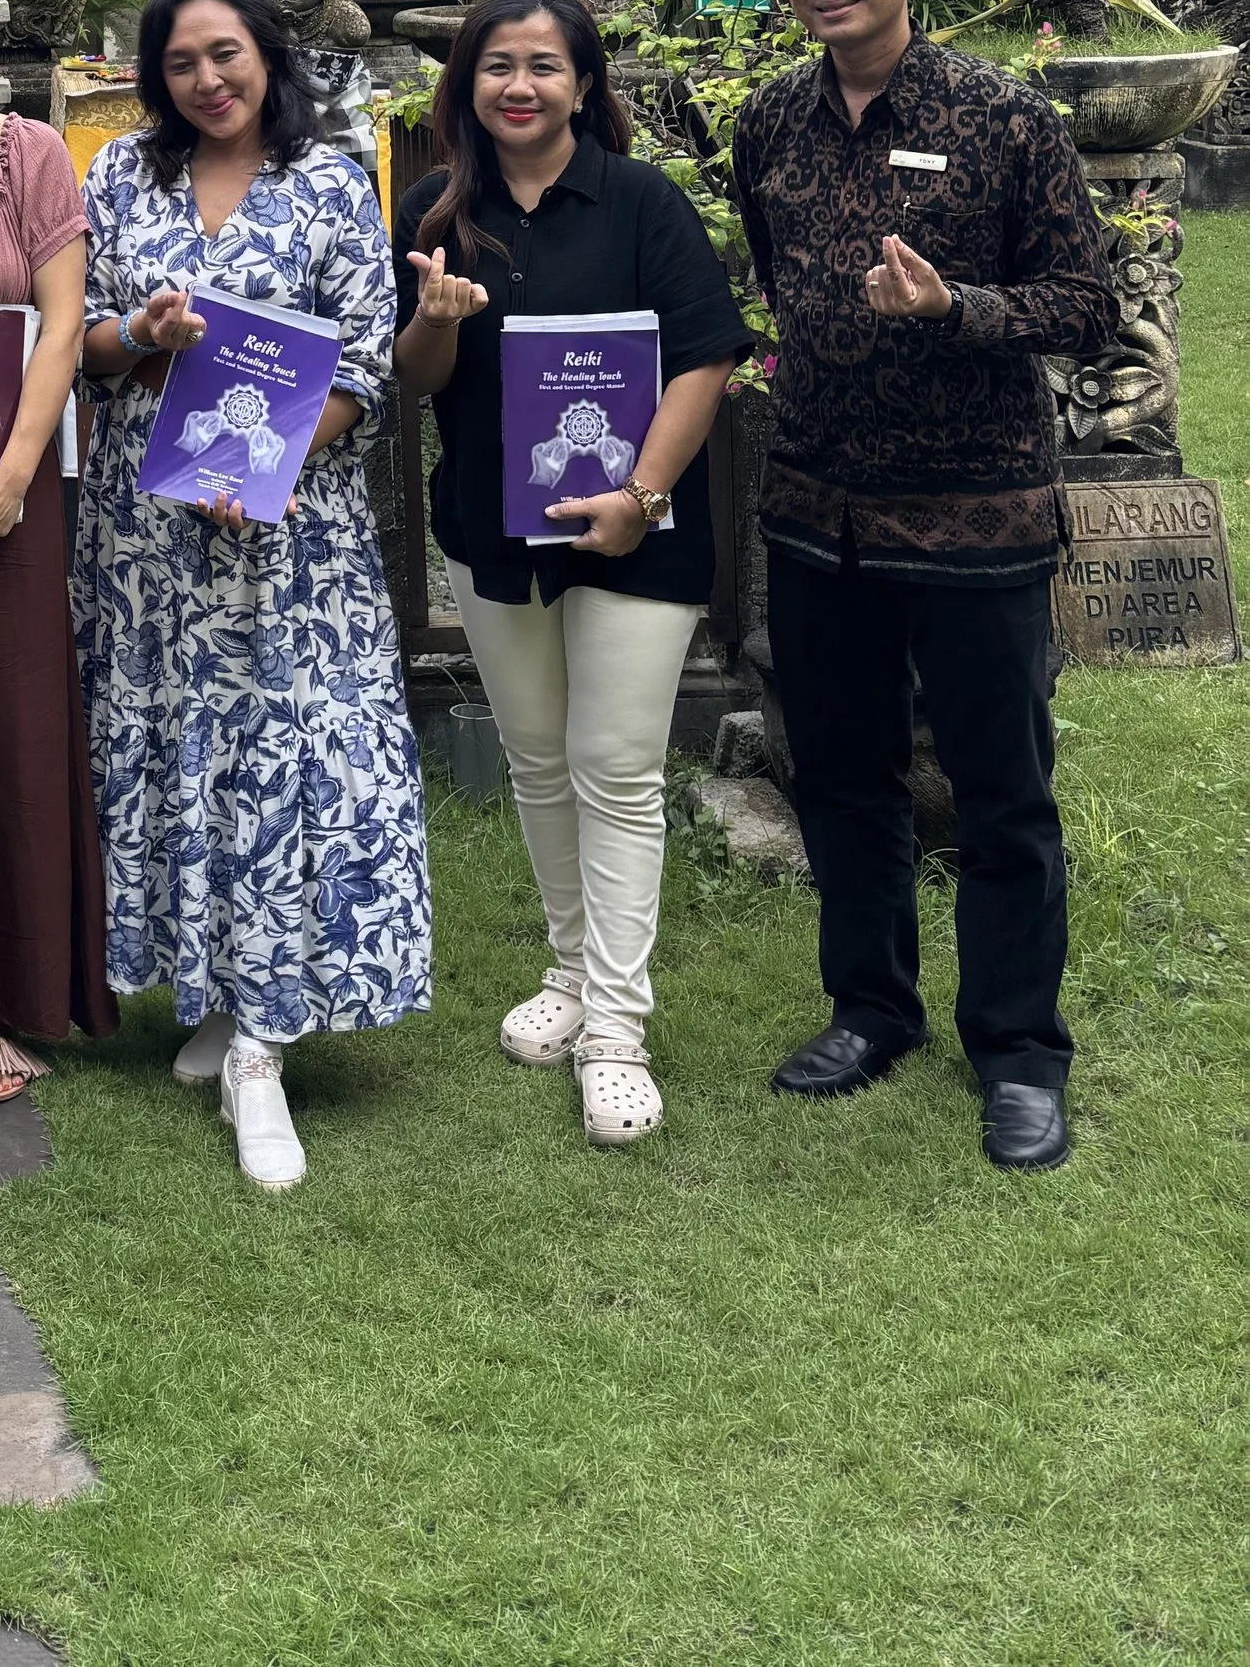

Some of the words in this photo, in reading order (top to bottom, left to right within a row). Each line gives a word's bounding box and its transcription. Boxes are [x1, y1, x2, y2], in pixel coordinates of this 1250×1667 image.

[243, 334, 284, 358] Reiki
[563, 350, 603, 366] Reiki
[219, 345, 235, 359] The
[236, 351, 270, 372] Healing
[272, 364, 297, 379] Touch
[543, 371, 559, 381] The
[561, 371, 595, 383] Healing
[598, 370, 622, 381] Touch
[1075, 501, 1212, 535] ILARANG
[1062, 556, 1218, 585] MENJEMUR
[1085, 594, 1112, 619] DI
[1121, 591, 1204, 618] AREA
[1107, 626, 1190, 652] PURA
